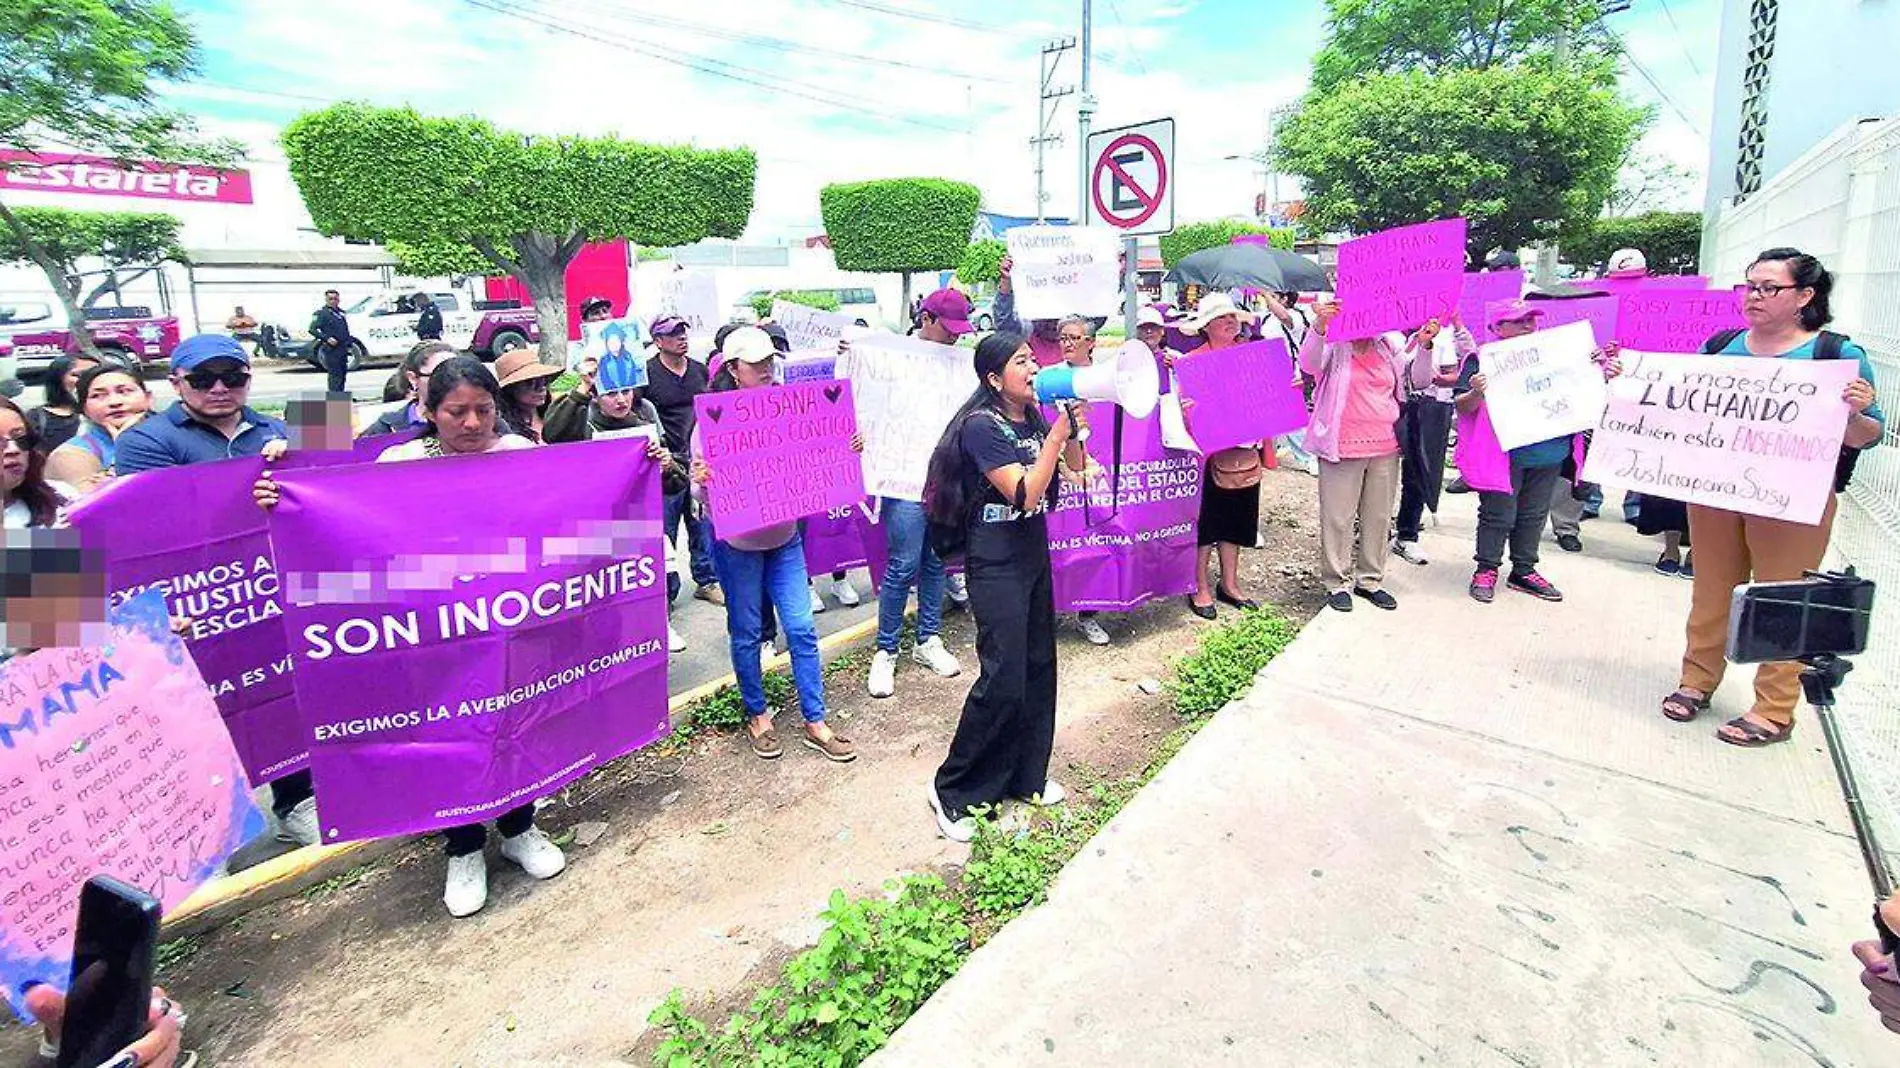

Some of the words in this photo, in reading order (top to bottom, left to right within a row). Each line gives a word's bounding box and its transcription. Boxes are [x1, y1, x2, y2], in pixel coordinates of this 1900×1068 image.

[1625, 356, 1663, 383] La
[1682, 366, 1818, 397] maestra
[733, 387, 820, 423] SUSANA
[1639, 383, 1801, 425] LUCHANDO
[706, 425, 784, 460] ESTAMOS
[1147, 469, 1199, 488] ESTADO
[1164, 484, 1199, 501] CASO
[253, 554, 272, 575] A
[192, 599, 283, 641] ESCLA
[302, 610, 420, 660] SON
[437, 555, 657, 640] INOCENTES
[33, 664, 60, 690] LA
[241, 667, 266, 688] ES
[313, 711, 421, 741] EXIGIMOS
[426, 704, 451, 722] LA
[456, 663, 585, 717] AVERIGUACION
[588, 638, 663, 673] COMPLETA
